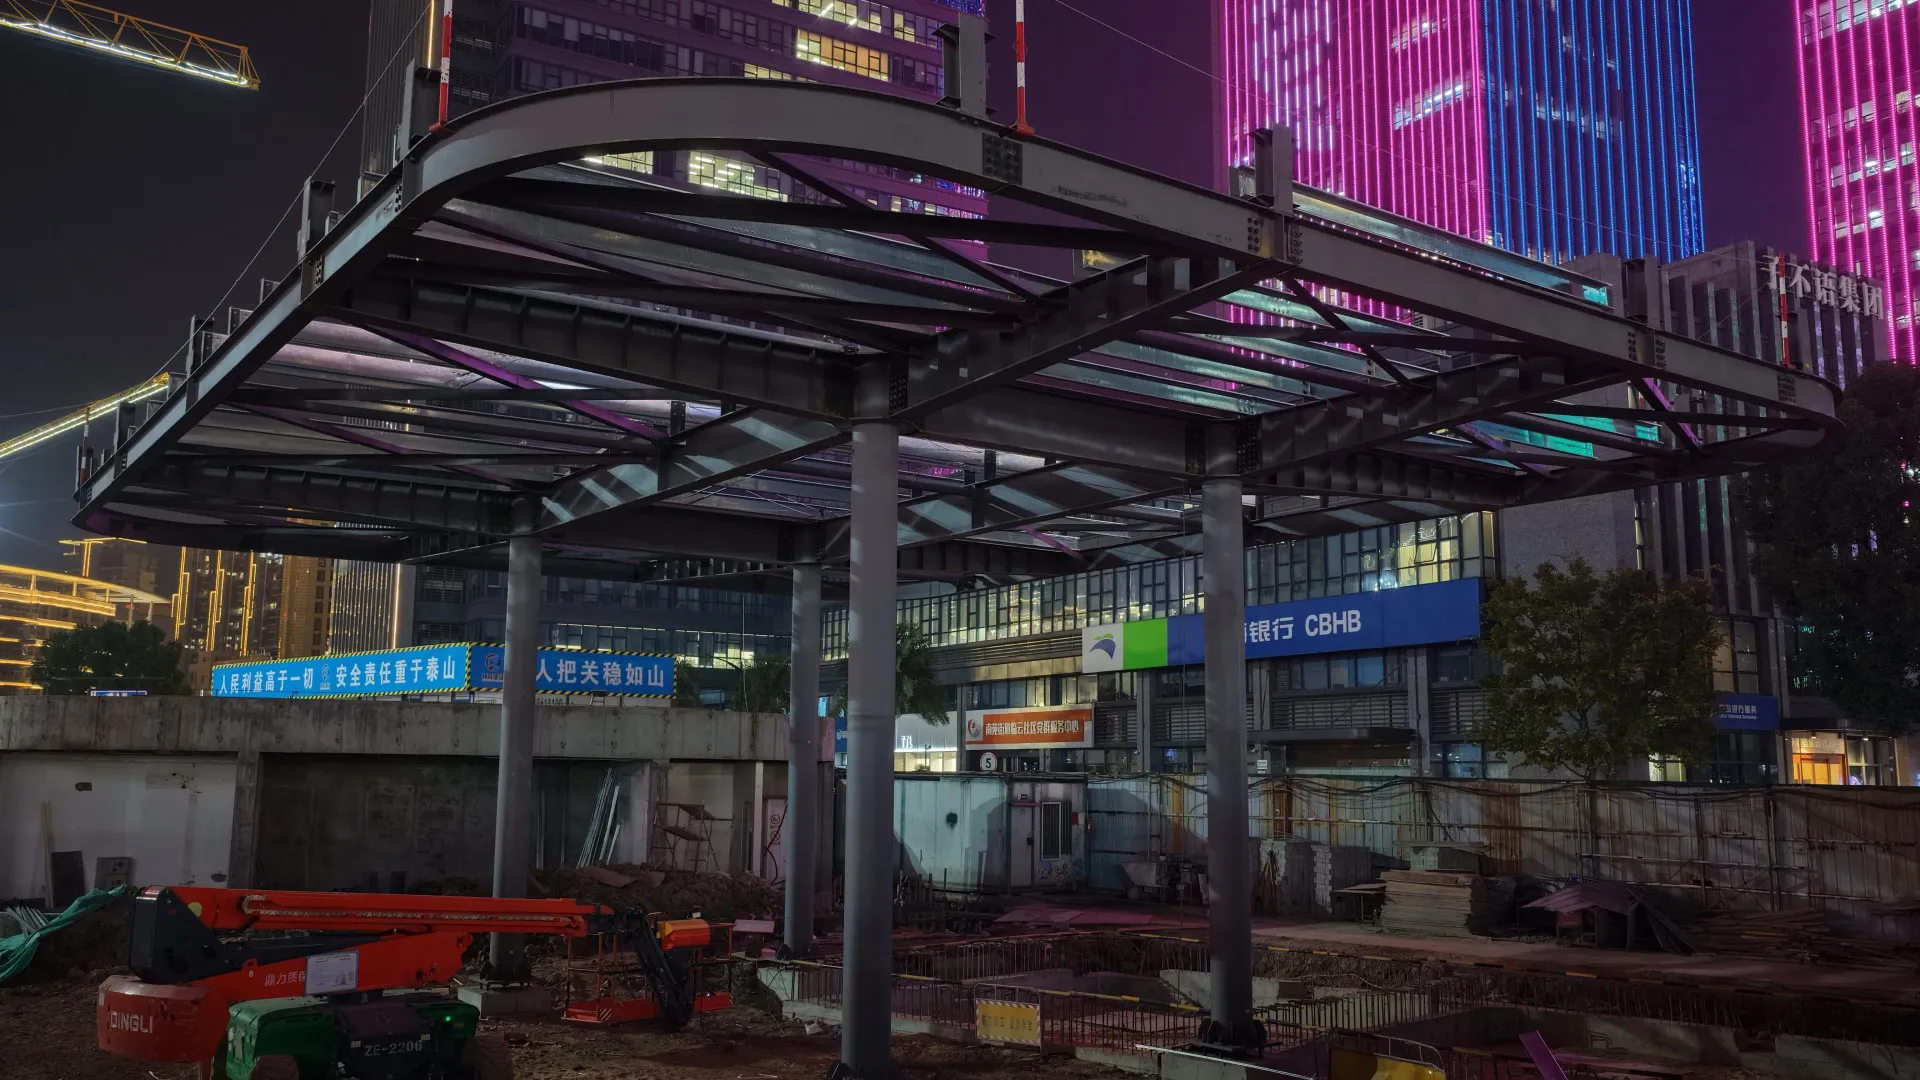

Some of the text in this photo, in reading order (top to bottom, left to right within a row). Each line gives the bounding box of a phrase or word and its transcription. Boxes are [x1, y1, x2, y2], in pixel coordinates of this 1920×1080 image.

[1244, 609, 1362, 643] 银行 CBHB
[219, 667, 314, 694] 人民利益高于一切
[336, 655, 456, 688] 安全责任重于泰山
[536, 658, 665, 687] 人把关稳如山
[985, 757, 992, 768] 5
[110, 1010, 154, 1034] DINGLI
